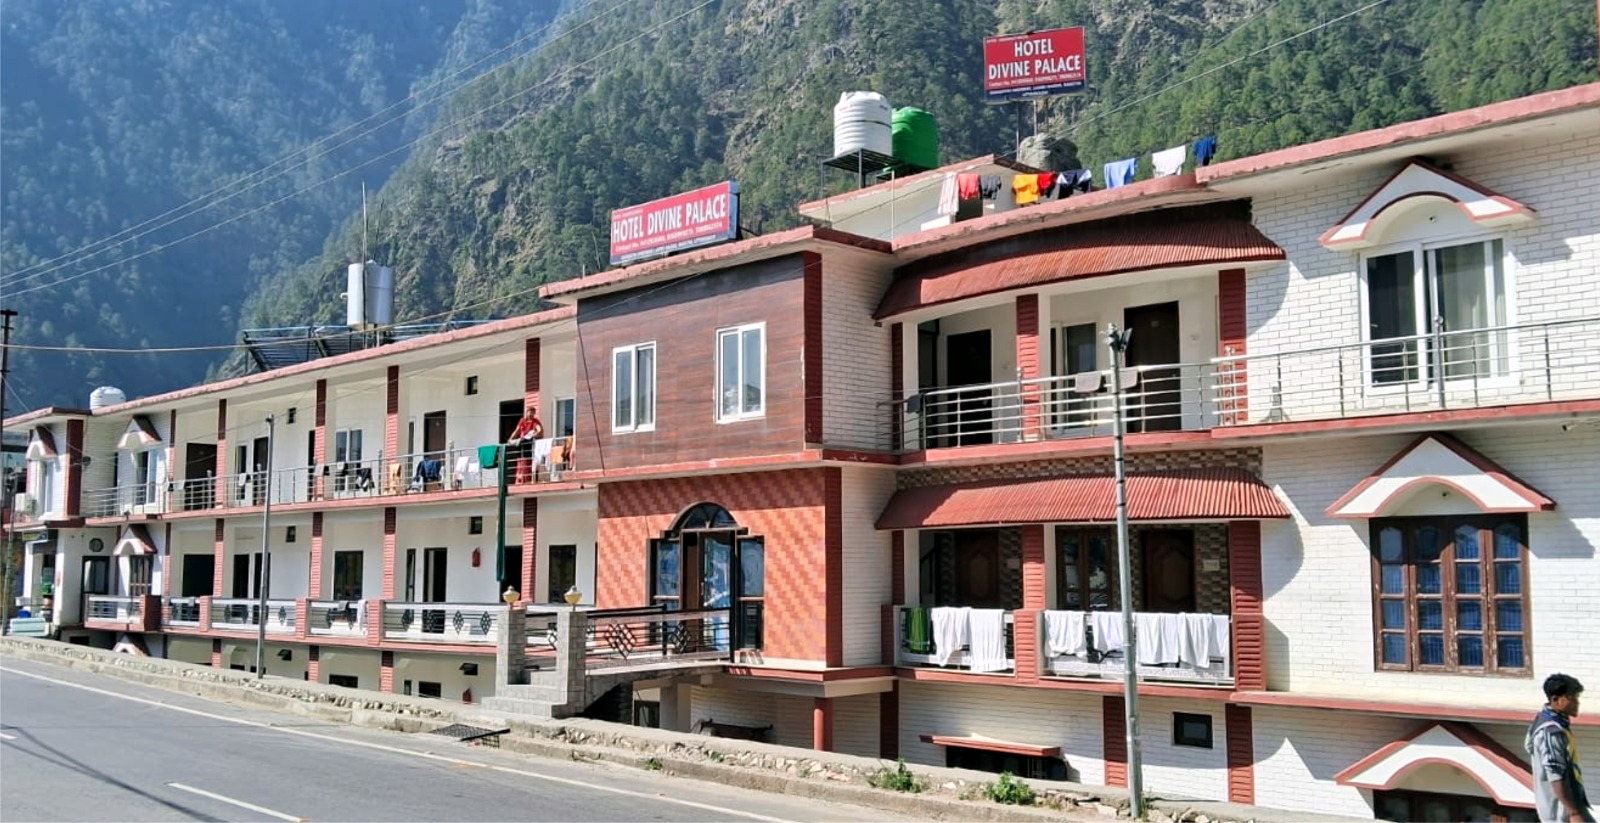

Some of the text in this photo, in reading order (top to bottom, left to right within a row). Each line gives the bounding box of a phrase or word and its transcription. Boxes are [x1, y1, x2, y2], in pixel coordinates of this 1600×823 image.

[1014, 38, 1054, 57] HOTEL
[988, 60, 1030, 80] DIVINE
[1034, 54, 1081, 75] PALACE
[612, 215, 644, 243] HOTEL
[647, 205, 682, 235] DIVINE
[685, 194, 726, 226] PALACE
